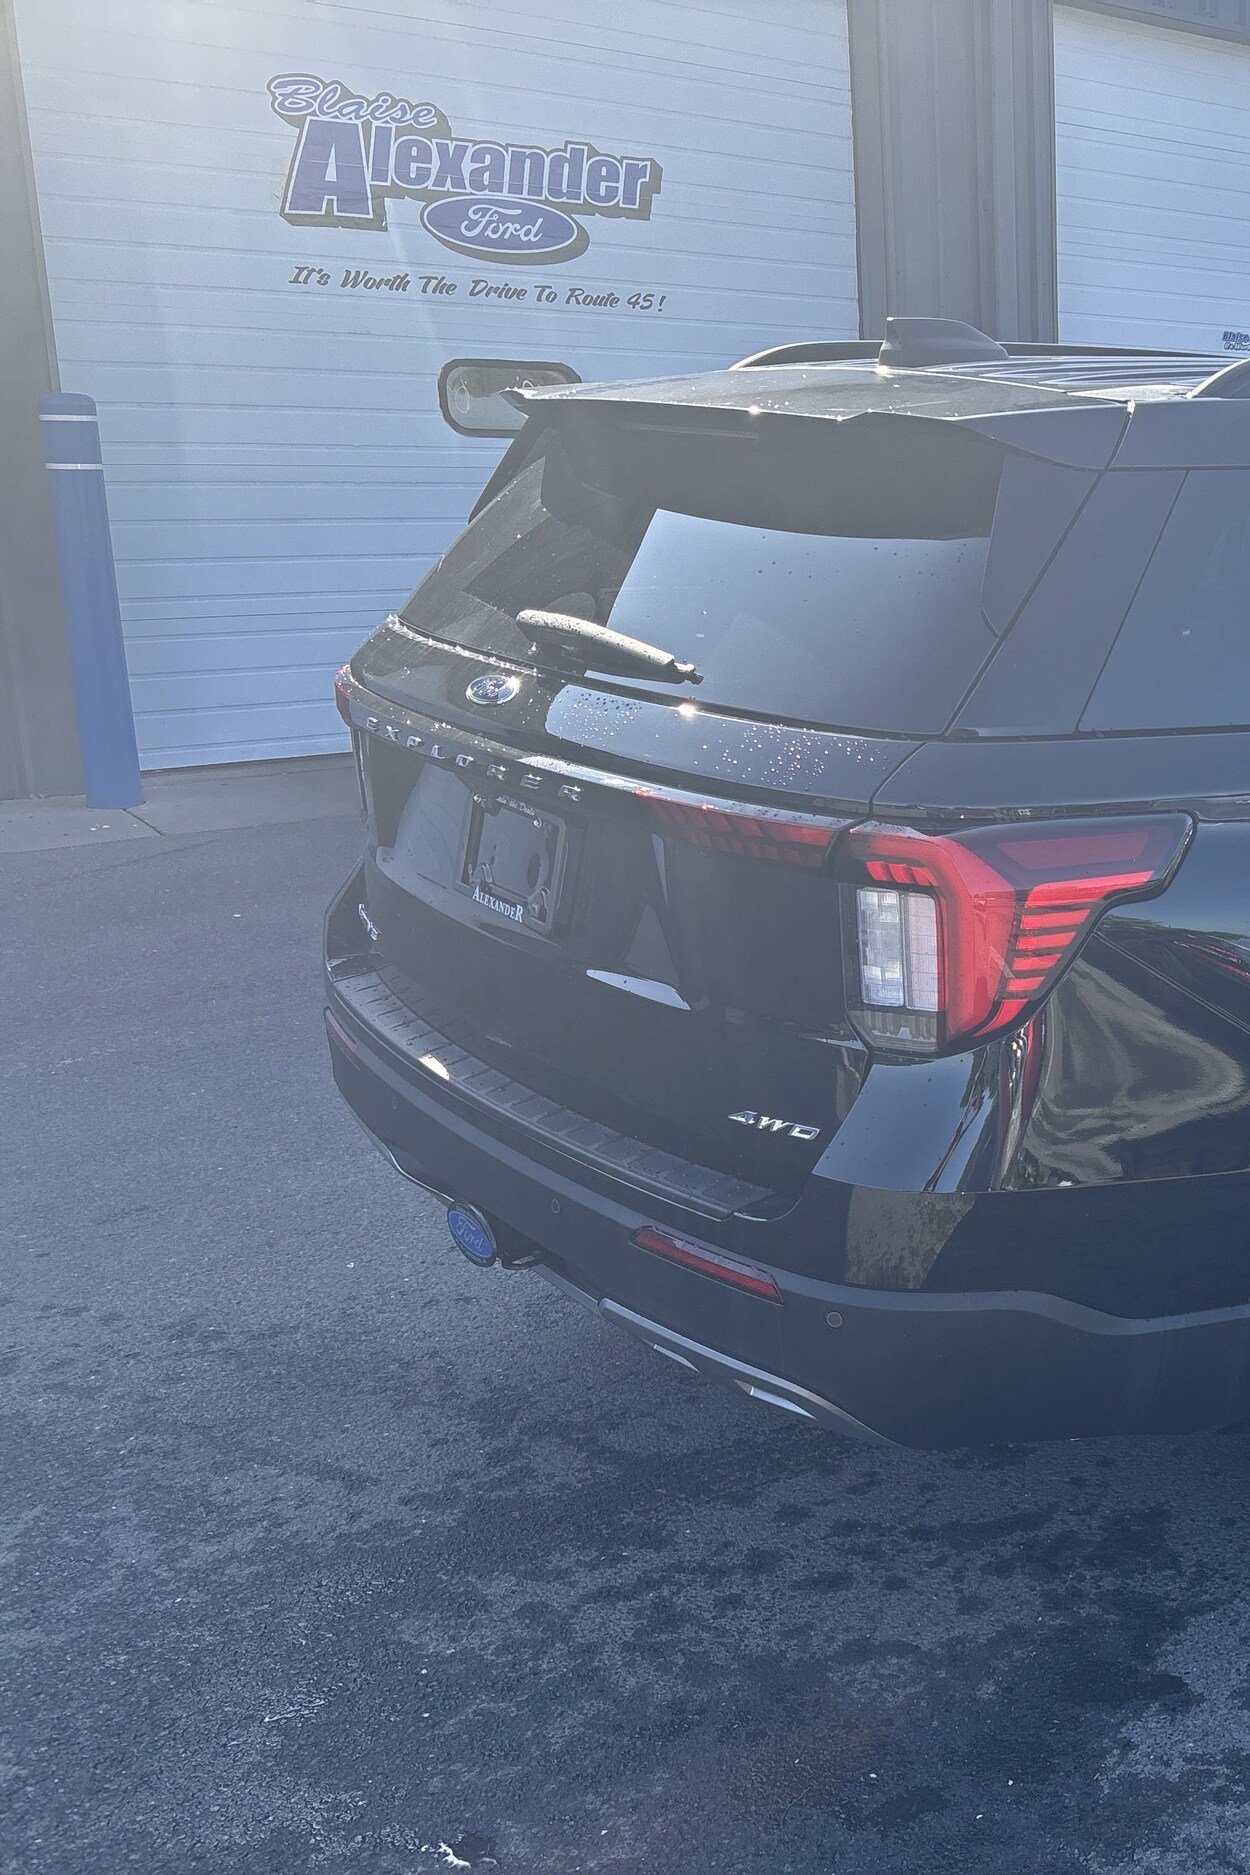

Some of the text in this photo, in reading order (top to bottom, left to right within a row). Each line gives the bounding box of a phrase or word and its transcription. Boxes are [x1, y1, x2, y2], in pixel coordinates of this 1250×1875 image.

[270, 78, 437, 127] Blaise
[287, 117, 650, 218] Alexander
[460, 204, 543, 243] Ford
[288, 265, 332, 286] It's
[340, 269, 411, 293] Worth
[418, 275, 458, 296] The
[468, 279, 528, 300] Drive
[533, 284, 558, 303] To
[565, 287, 621, 308] Route
[366, 716, 584, 802] EXPLORER
[472, 885, 524, 923] ALEXANDER
[728, 1110, 821, 1140] 4WD
[456, 1216, 484, 1252] Ford
